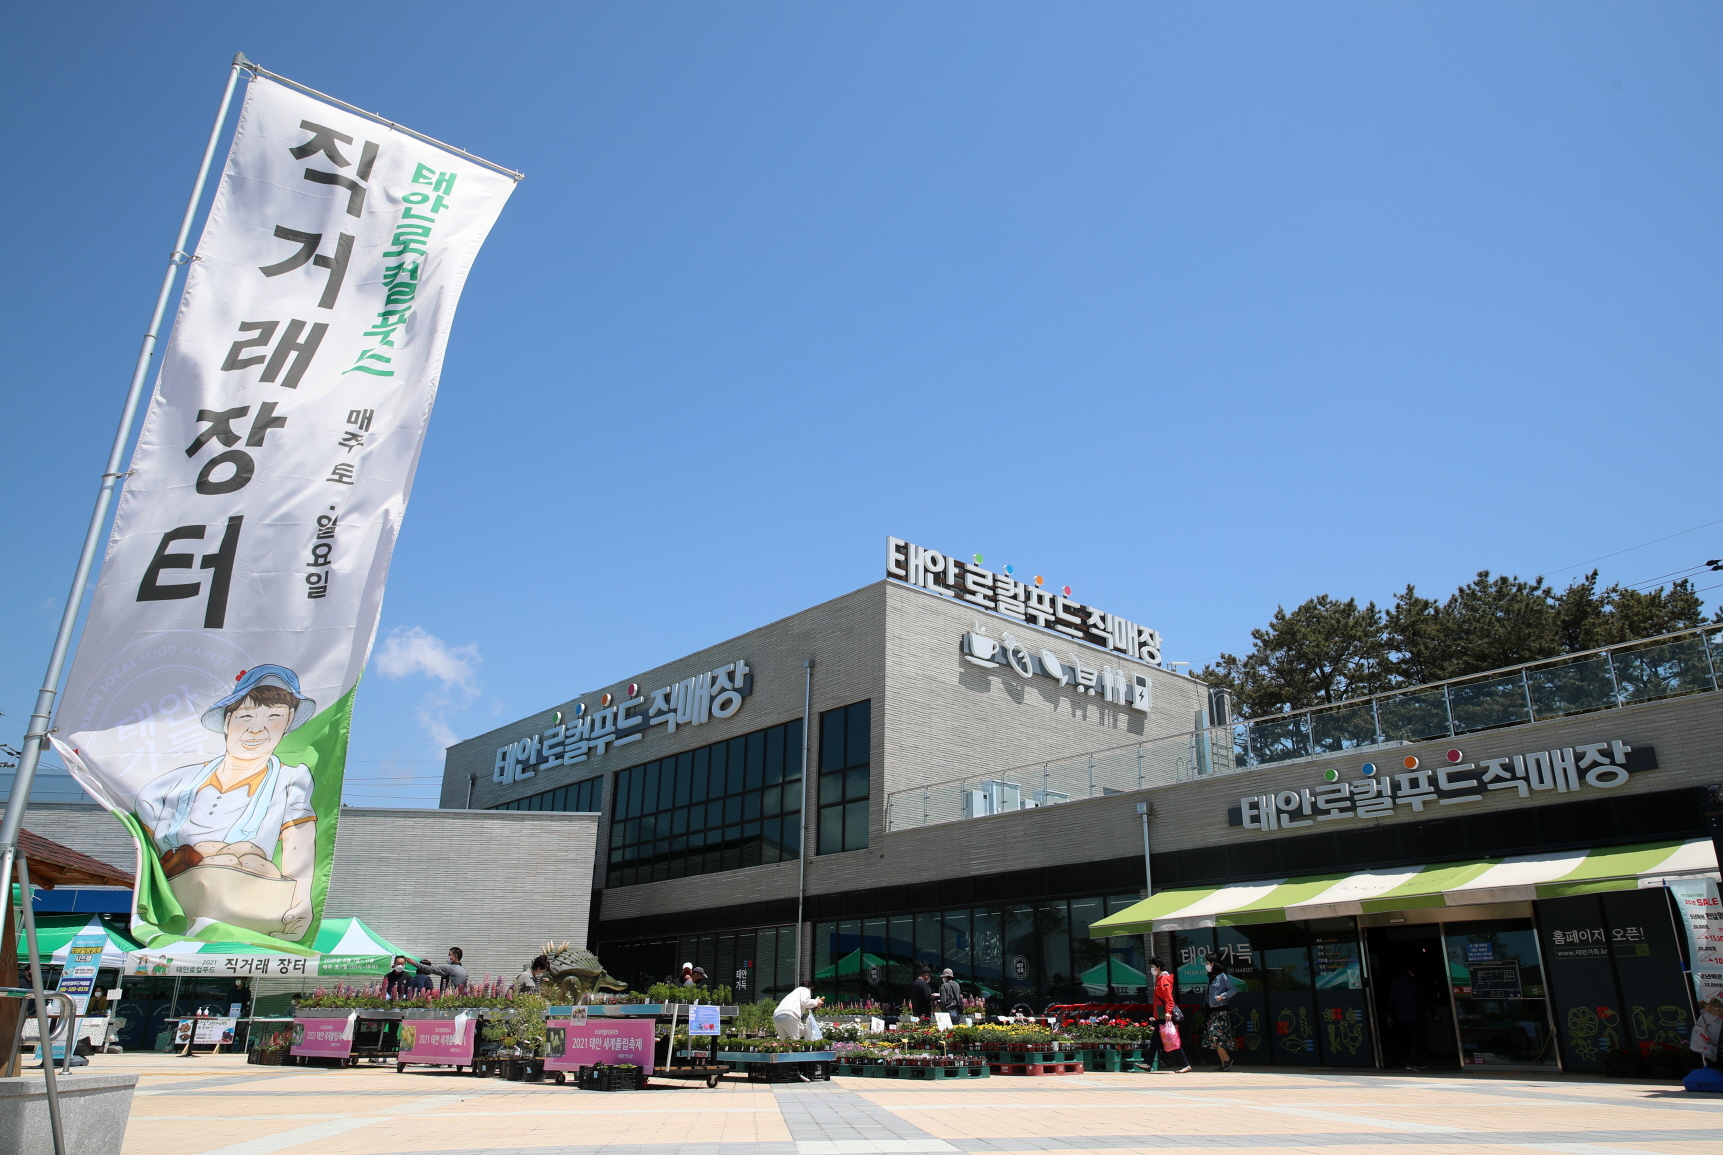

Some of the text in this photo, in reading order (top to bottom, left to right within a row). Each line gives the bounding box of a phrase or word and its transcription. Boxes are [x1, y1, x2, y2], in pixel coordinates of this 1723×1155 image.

[337, 408, 375, 453] 매주
[101, 659, 137, 693] LOCAL
[140, 645, 177, 663] FOOD
[181, 646, 231, 668] MARKET
[114, 684, 199, 742] 태안
[119, 723, 209, 777] 가득
[1697, 898, 1719, 906] SALE
[1552, 926, 1645, 945] 홈페이지 오픈!
[1181, 943, 1253, 966] 태안 가득
[1557, 948, 1608, 957] www.태안가득.kr
[176, 965, 216, 974] 태안로컬푸드
[224, 958, 307, 975] 직거래 장터
[307, 1031, 317, 1040] 2021
[316, 1031, 324, 1041] 태안
[419, 1034, 430, 1044] 2021
[431, 1034, 440, 1045] 태안
[572, 1037, 643, 1051] 2021 태안 세계튤립축제
